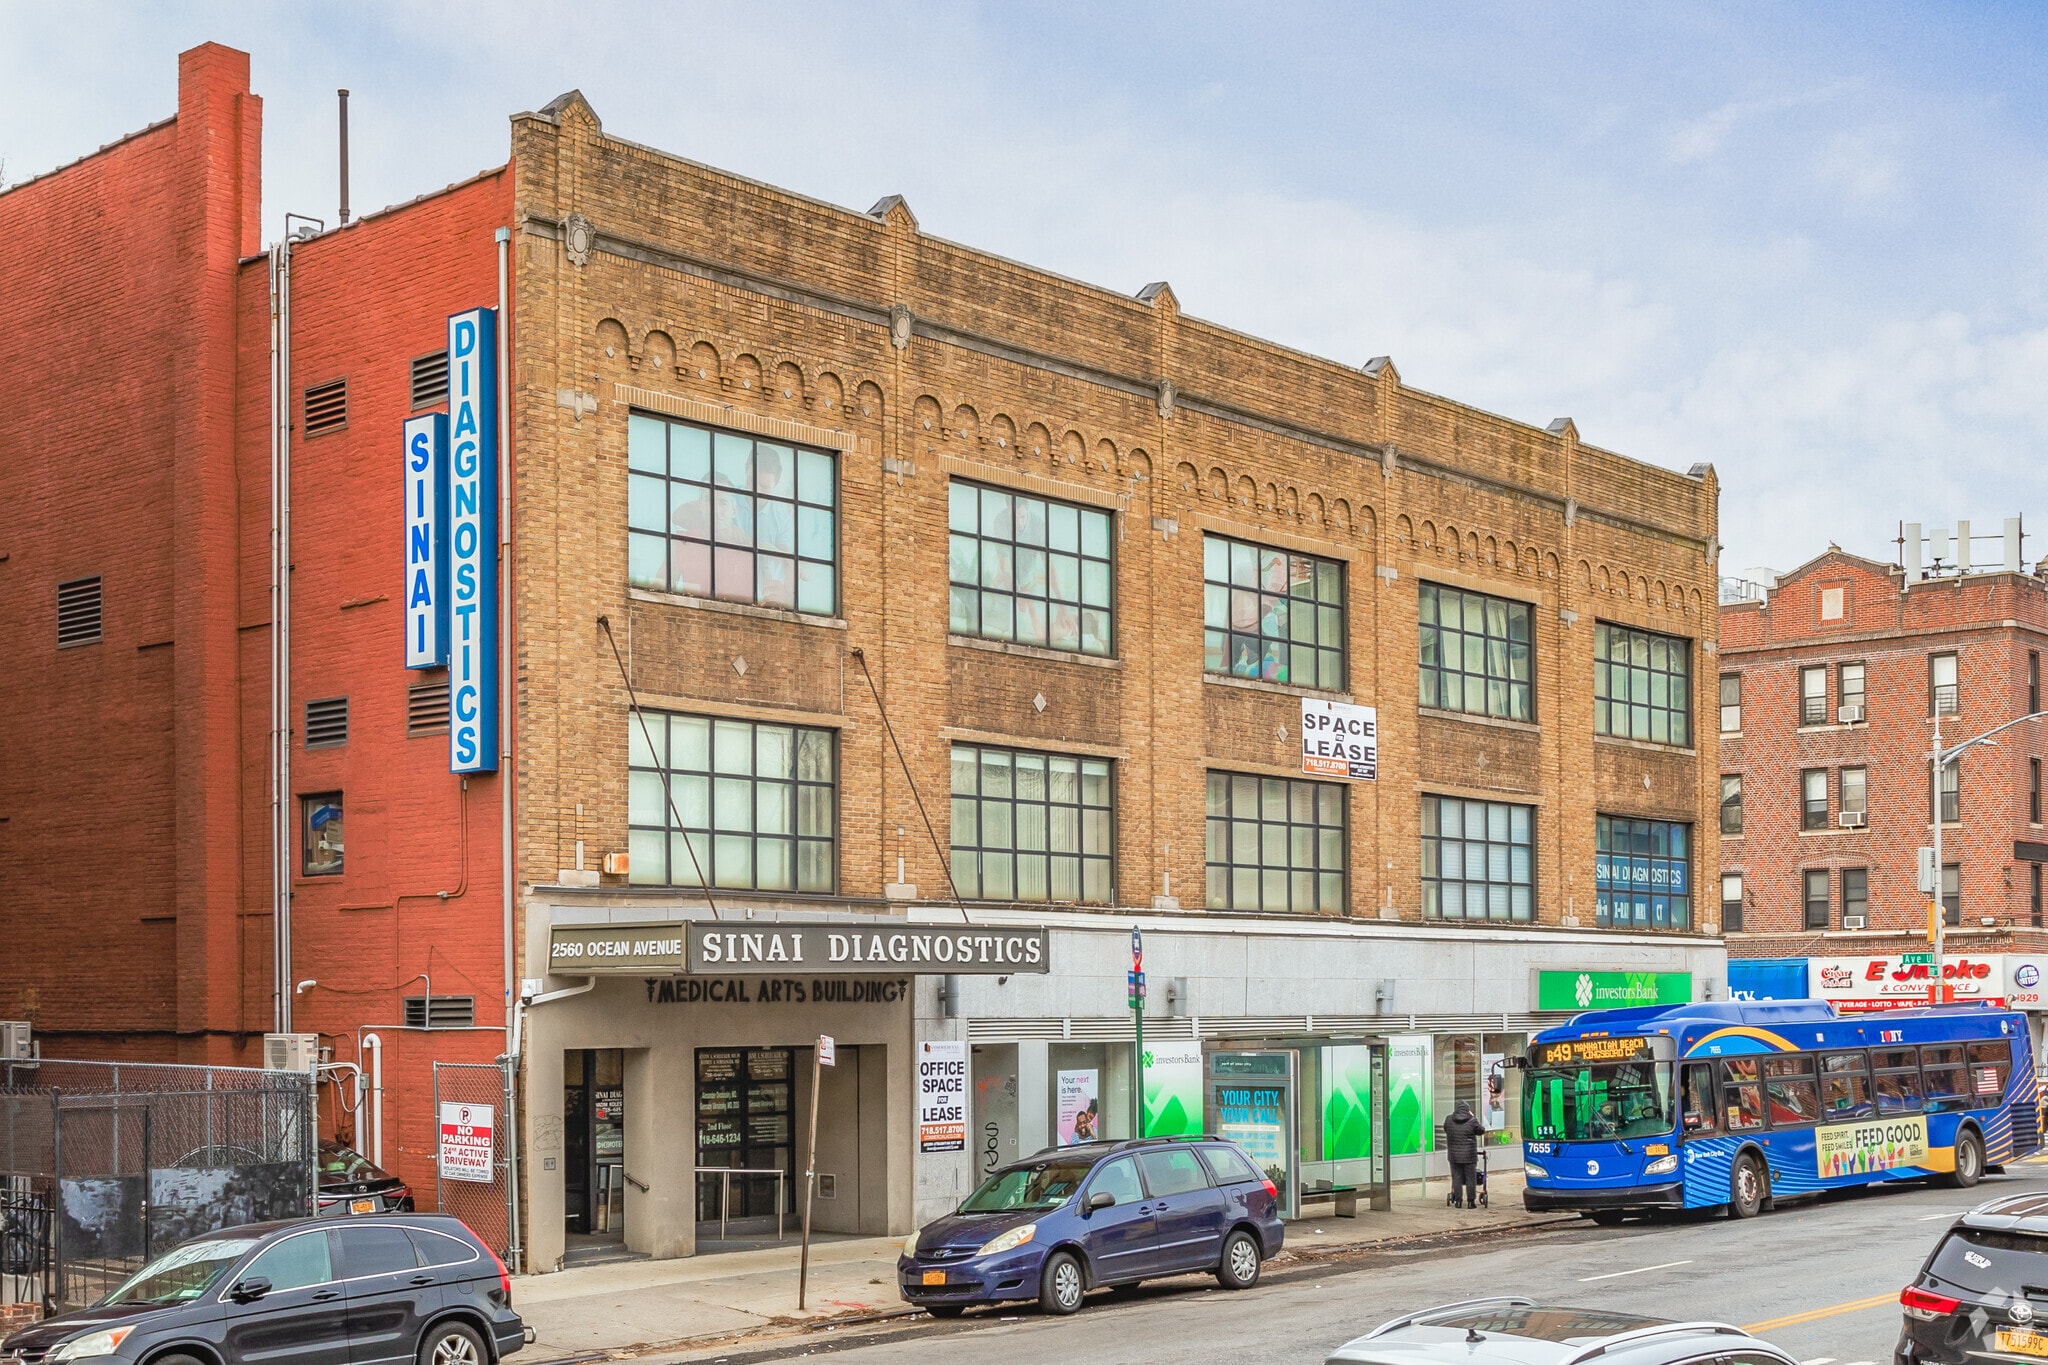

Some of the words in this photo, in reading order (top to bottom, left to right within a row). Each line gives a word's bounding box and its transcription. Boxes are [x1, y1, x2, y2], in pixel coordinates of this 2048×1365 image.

[410, 432, 433, 654] SINAI
[453, 319, 479, 765] DIAGNOSTICS
[1304, 713, 1375, 737] SPACE
[1304, 738, 1376, 762] LEASE
[1597, 864, 1620, 880] SINAI
[1622, 866, 1682, 884] DIAGNOSTICS
[552, 942, 584, 958] 2560
[587, 940, 630, 956] OCEAN
[633, 939, 682, 956] AVENUE
[702, 932, 804, 963] SINAI
[828, 934, 1042, 963] DIAGNOSTICS
[1904, 955, 1920, 963] Ave
[1926, 954, 1932, 963] U
[1821, 967, 1851, 979] Cigar
[657, 979, 750, 1003] MEDICAL
[757, 980, 807, 1002] ARTS
[812, 979, 898, 1002] BUILDING
[1596, 982, 1659, 999] investorsBank
[1893, 983, 1971, 991] CONVENCE
[1838, 1000, 1868, 1008] EVERAGE
[1574, 1039, 1618, 1052] MANHATTAN
[1620, 1037, 1644, 1050] BEACH
[1546, 1043, 1572, 1063] B49
[1583, 1049, 1624, 1060] KINGSBORO
[1625, 1048, 1636, 1057] CC
[920, 1061, 964, 1076] OFFICE
[923, 1078, 962, 1093] SPACE
[1061, 1076, 1075, 1084] Your
[1076, 1076, 1089, 1084] next
[1222, 1090, 1251, 1105] YOUR
[1253, 1091, 1279, 1106] CITY.
[923, 1107, 962, 1122] LEASE
[1221, 1107, 1249, 1122] YOUR
[457, 1126, 474, 1135] NO
[921, 1125, 964, 1135] 718.517.8700
[1821, 1132, 1833, 1141] FEED
[1855, 1127, 1884, 1148] FEED
[1886, 1123, 1922, 1143] GOOD.
[442, 1134, 490, 1146] PARKING
[1822, 1143, 1835, 1151] FEED
[459, 1148, 489, 1158] ACTIVE
[1528, 1143, 1551, 1154] 7655
[445, 1156, 487, 1167] DRIVEWAY
